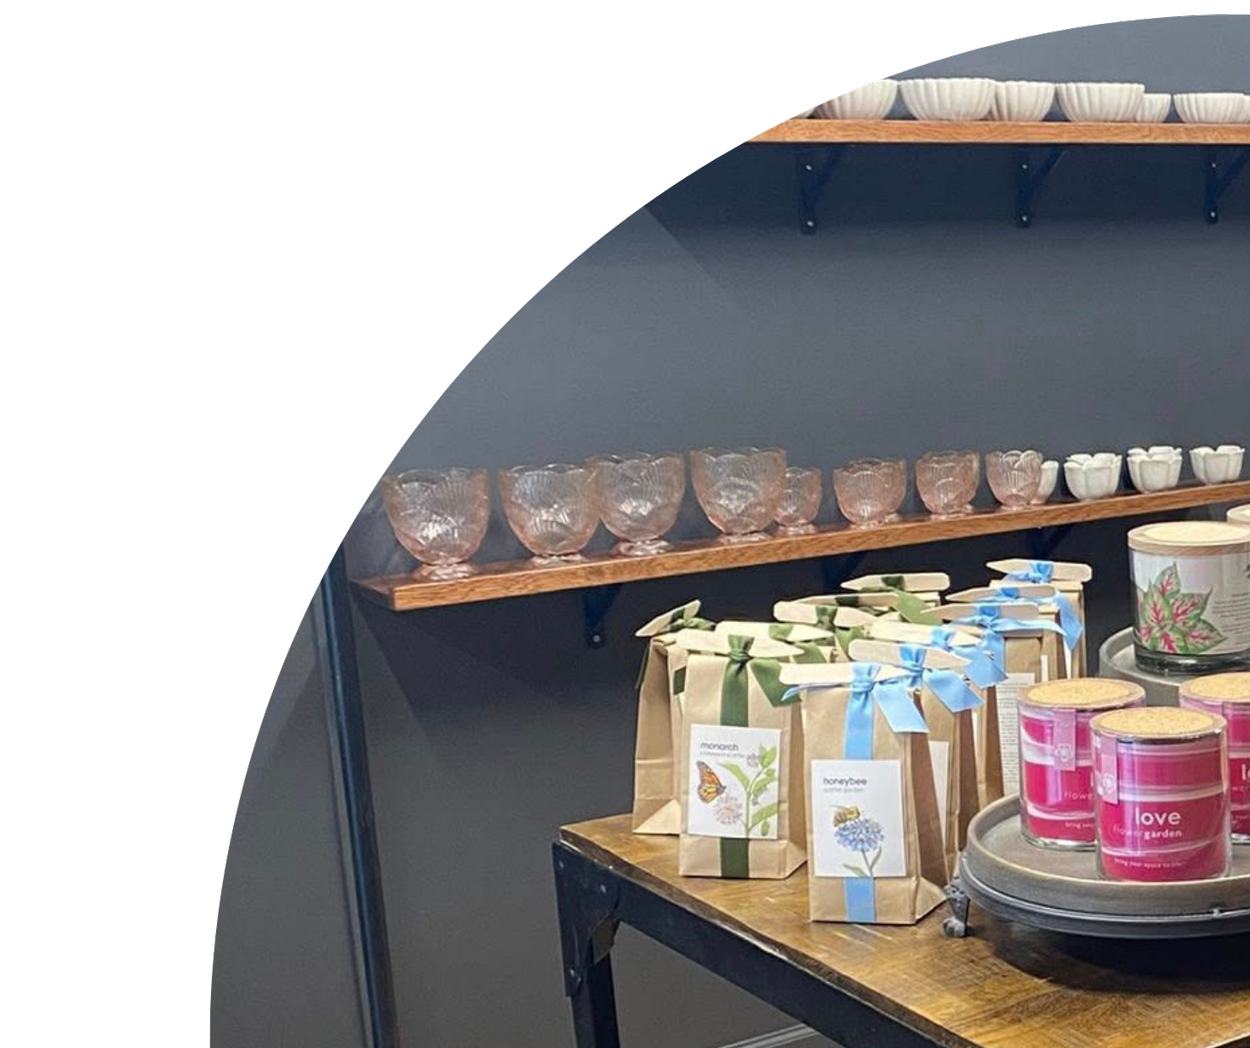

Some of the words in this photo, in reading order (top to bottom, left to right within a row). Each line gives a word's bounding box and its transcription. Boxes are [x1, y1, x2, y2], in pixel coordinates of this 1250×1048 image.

[700, 742, 739, 751] monarch
[823, 777, 867, 787] honeybee
[1135, 806, 1181, 826] love
